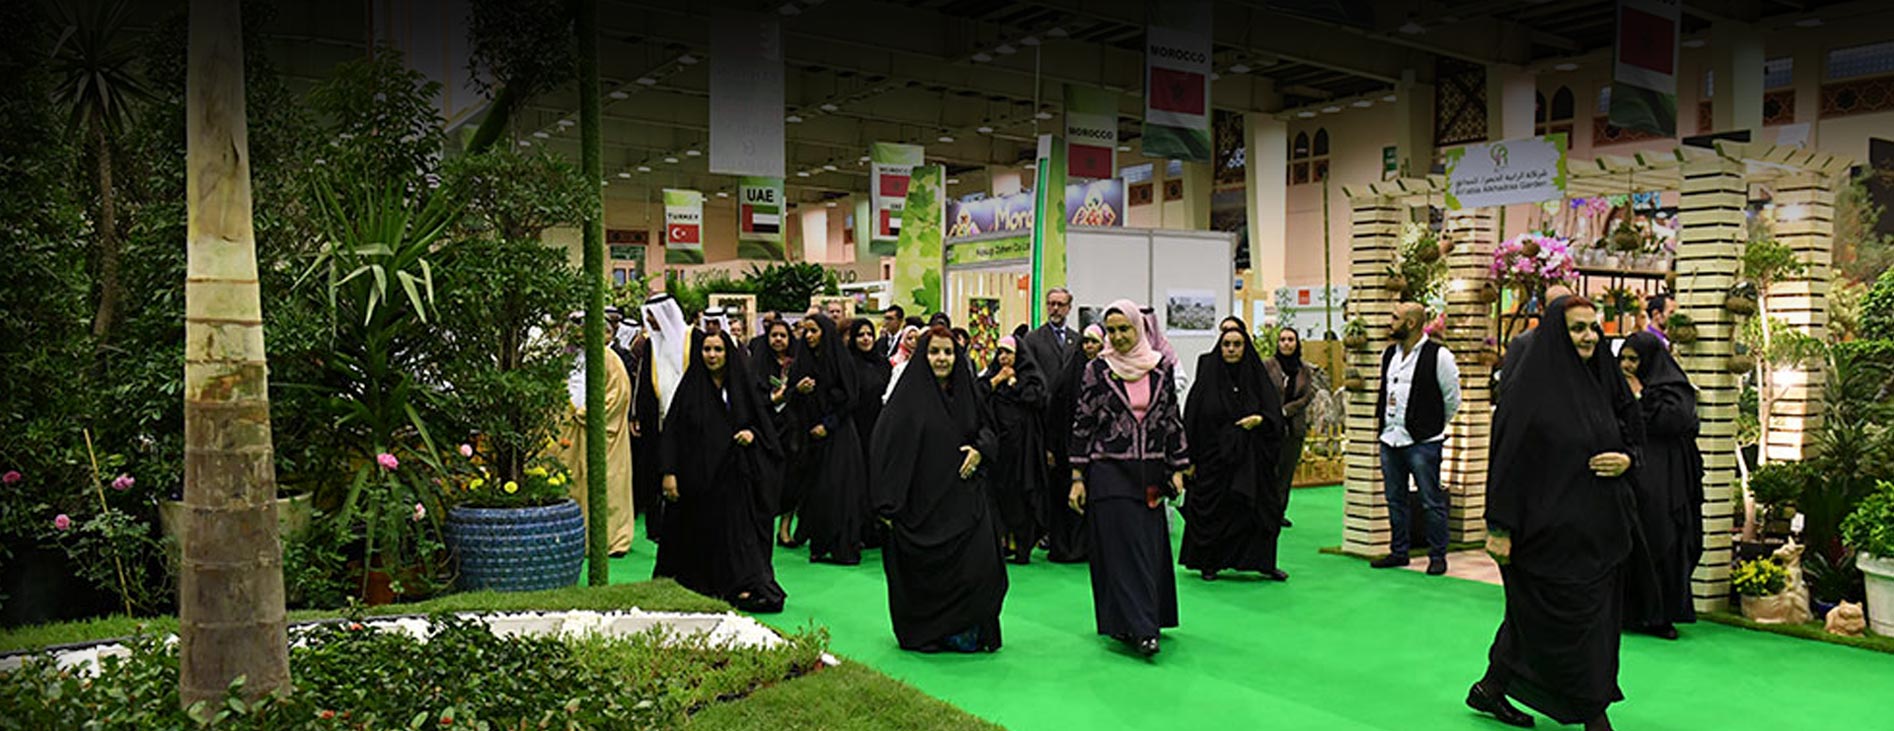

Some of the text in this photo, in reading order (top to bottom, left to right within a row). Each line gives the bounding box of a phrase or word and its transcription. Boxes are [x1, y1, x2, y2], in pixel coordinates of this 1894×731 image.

[1151, 45, 1206, 63] MOROCCO
[1069, 127, 1113, 139] MOROCCO
[747, 188, 774, 203] UAE
